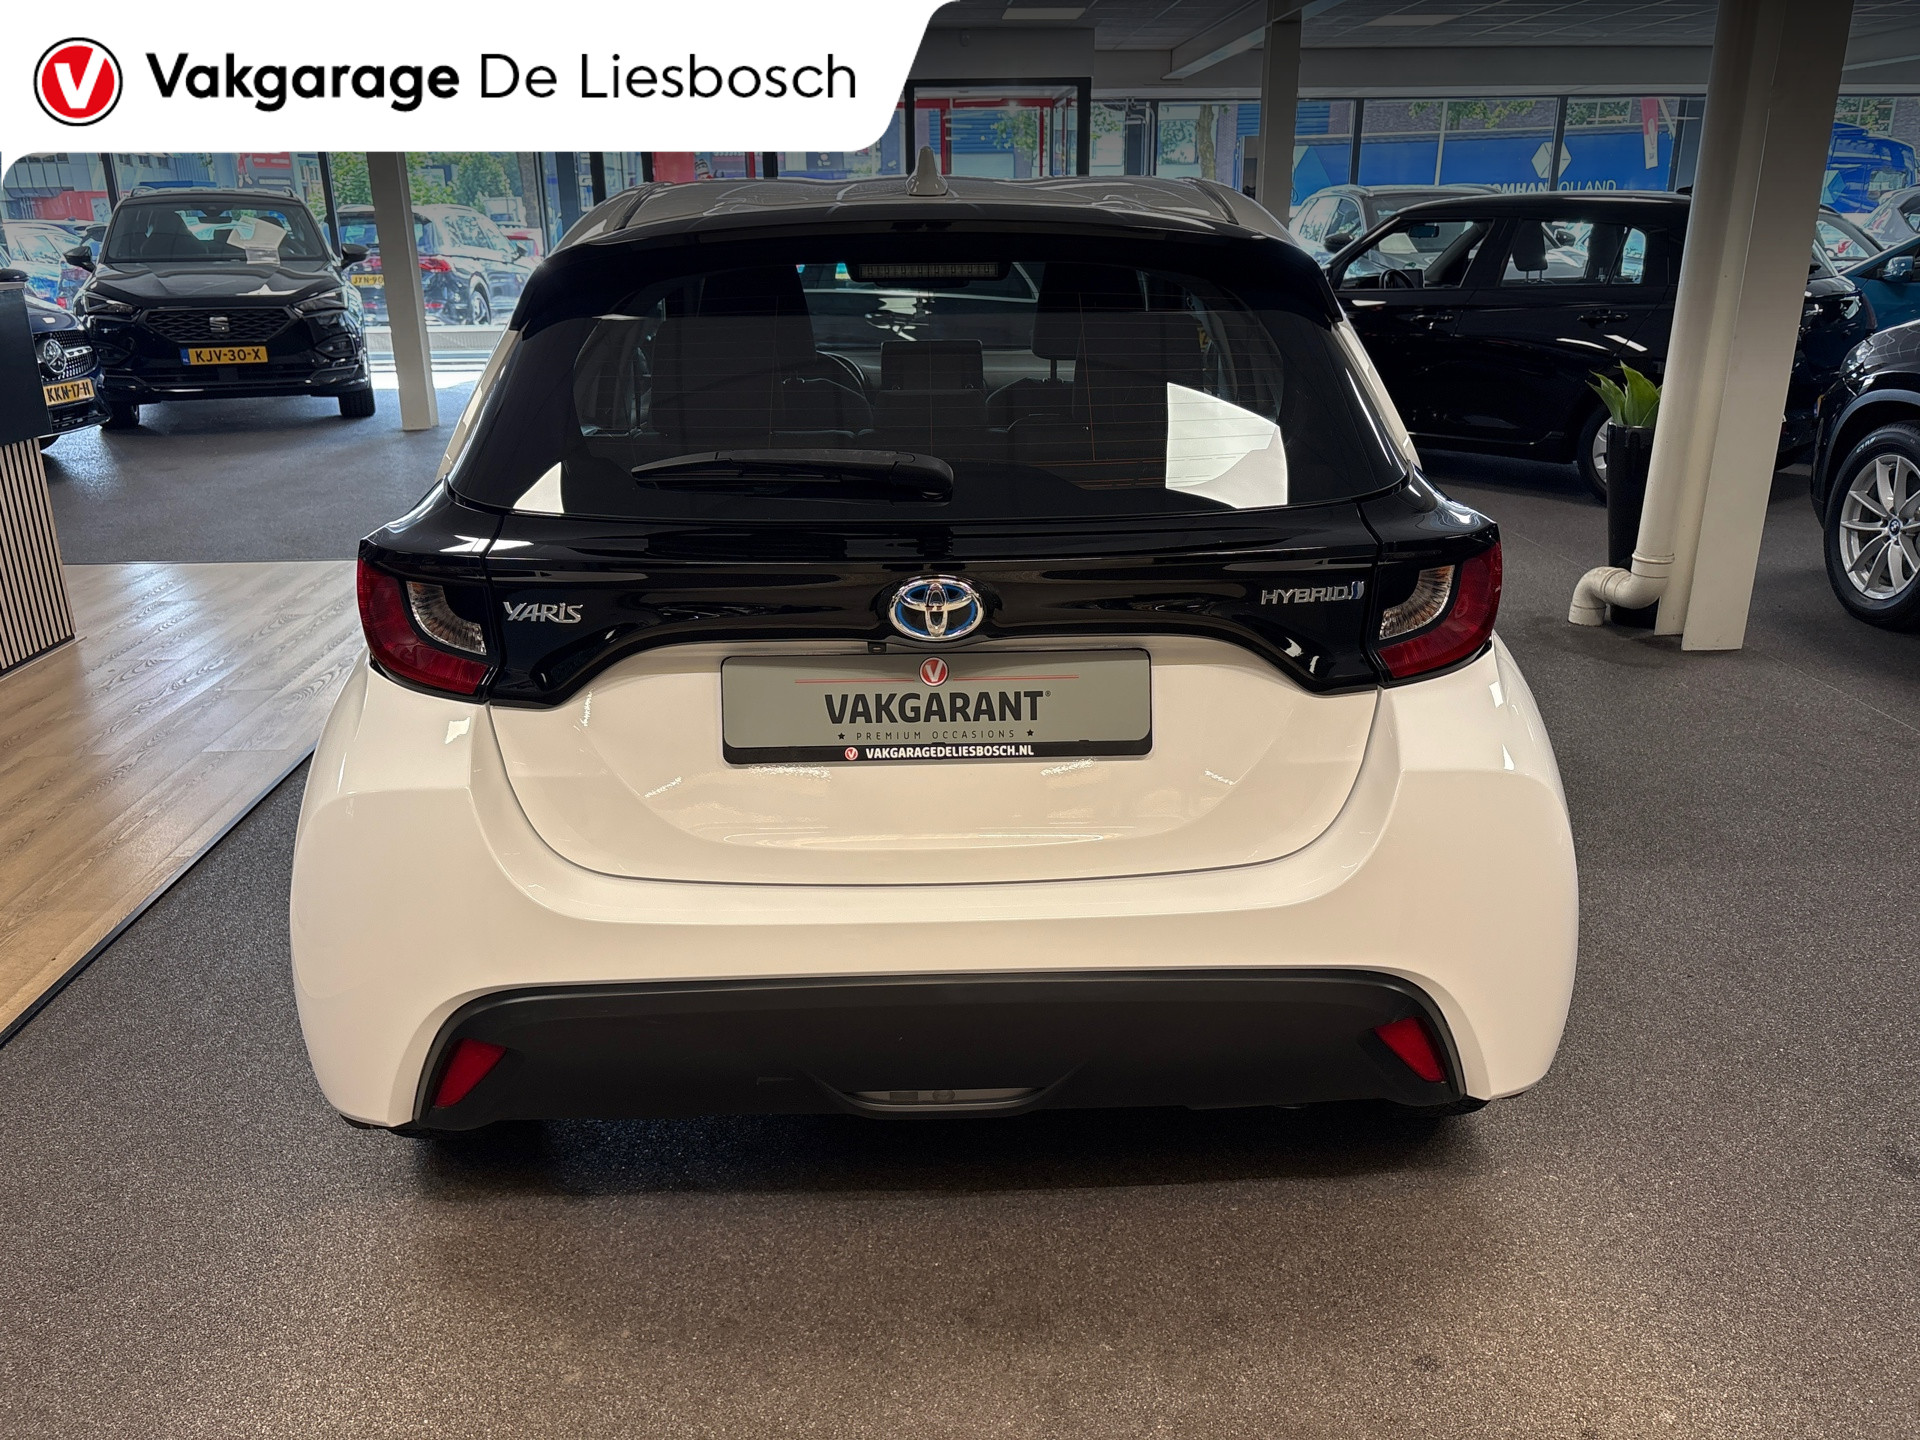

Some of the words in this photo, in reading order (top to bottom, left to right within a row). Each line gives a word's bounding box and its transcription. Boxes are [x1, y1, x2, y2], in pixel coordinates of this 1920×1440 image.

[194, 347, 262, 363] KJV-30-X
[46, 380, 92, 402] KKN-17-H
[1260, 585, 1350, 605] HYBRID
[502, 601, 584, 624] YARIS
[856, 731, 922, 741] PREMIUM
[931, 729, 1015, 740] OCCASIONS
[865, 744, 1035, 760] VAKGARAGEDELIESBOSCH.NL
